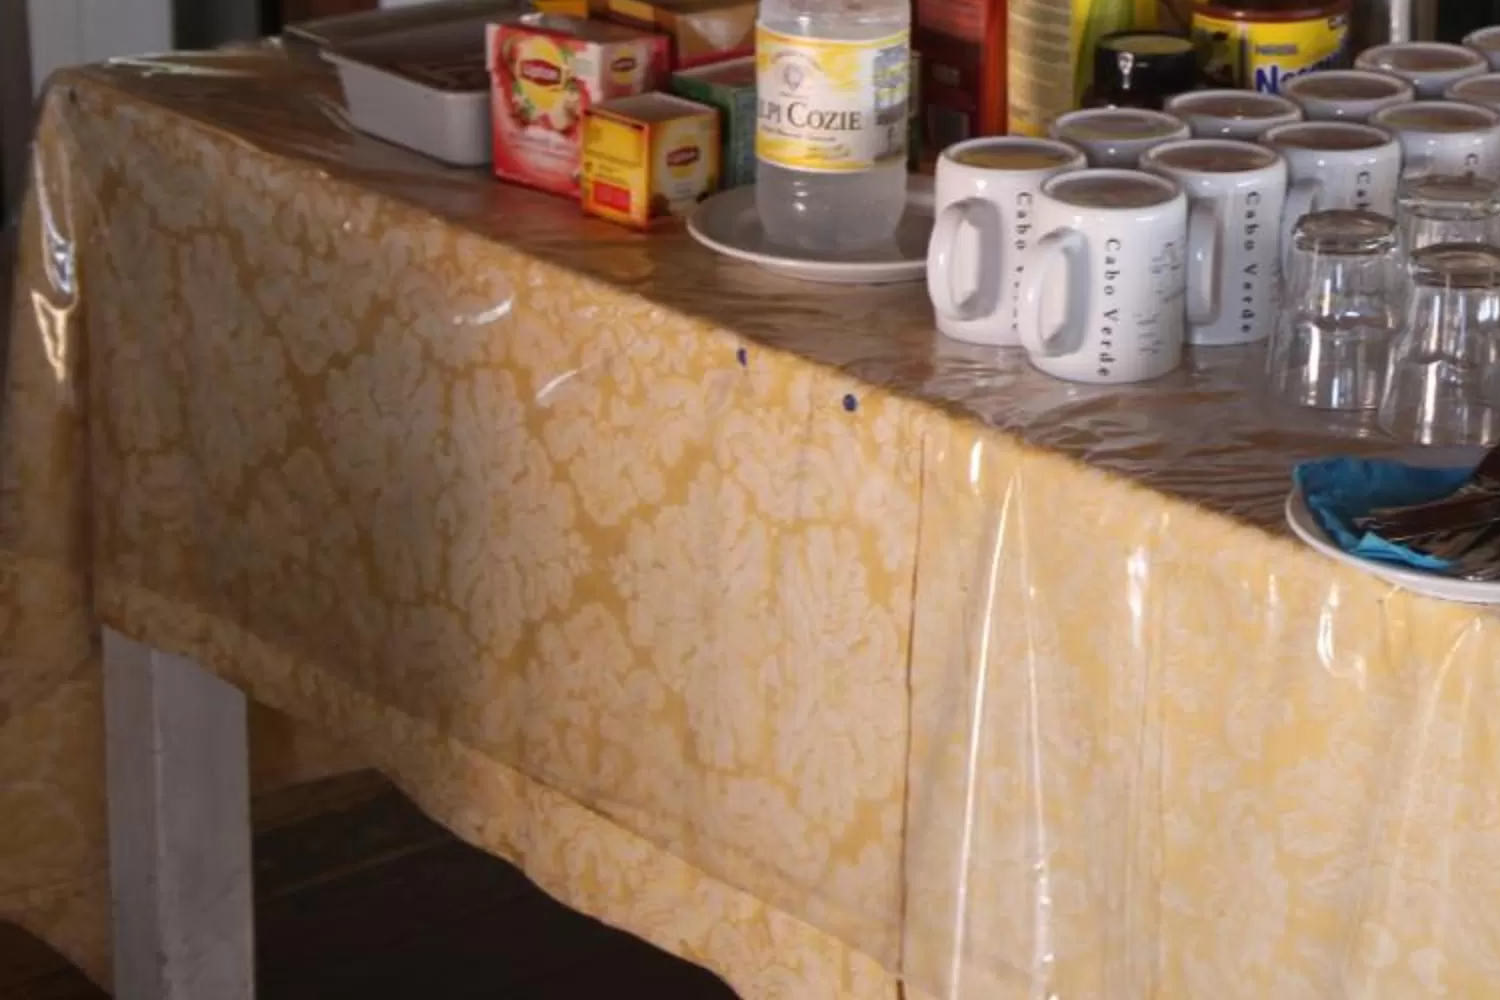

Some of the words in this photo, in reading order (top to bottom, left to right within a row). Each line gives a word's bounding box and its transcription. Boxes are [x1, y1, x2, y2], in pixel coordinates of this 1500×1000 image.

[1015, 191, 1033, 250] Cabo
[1243, 190, 1260, 251] Cabo
[1103, 237, 1121, 296] Cabo
[1240, 263, 1259, 333] Verde
[1097, 308, 1120, 377] Verde
